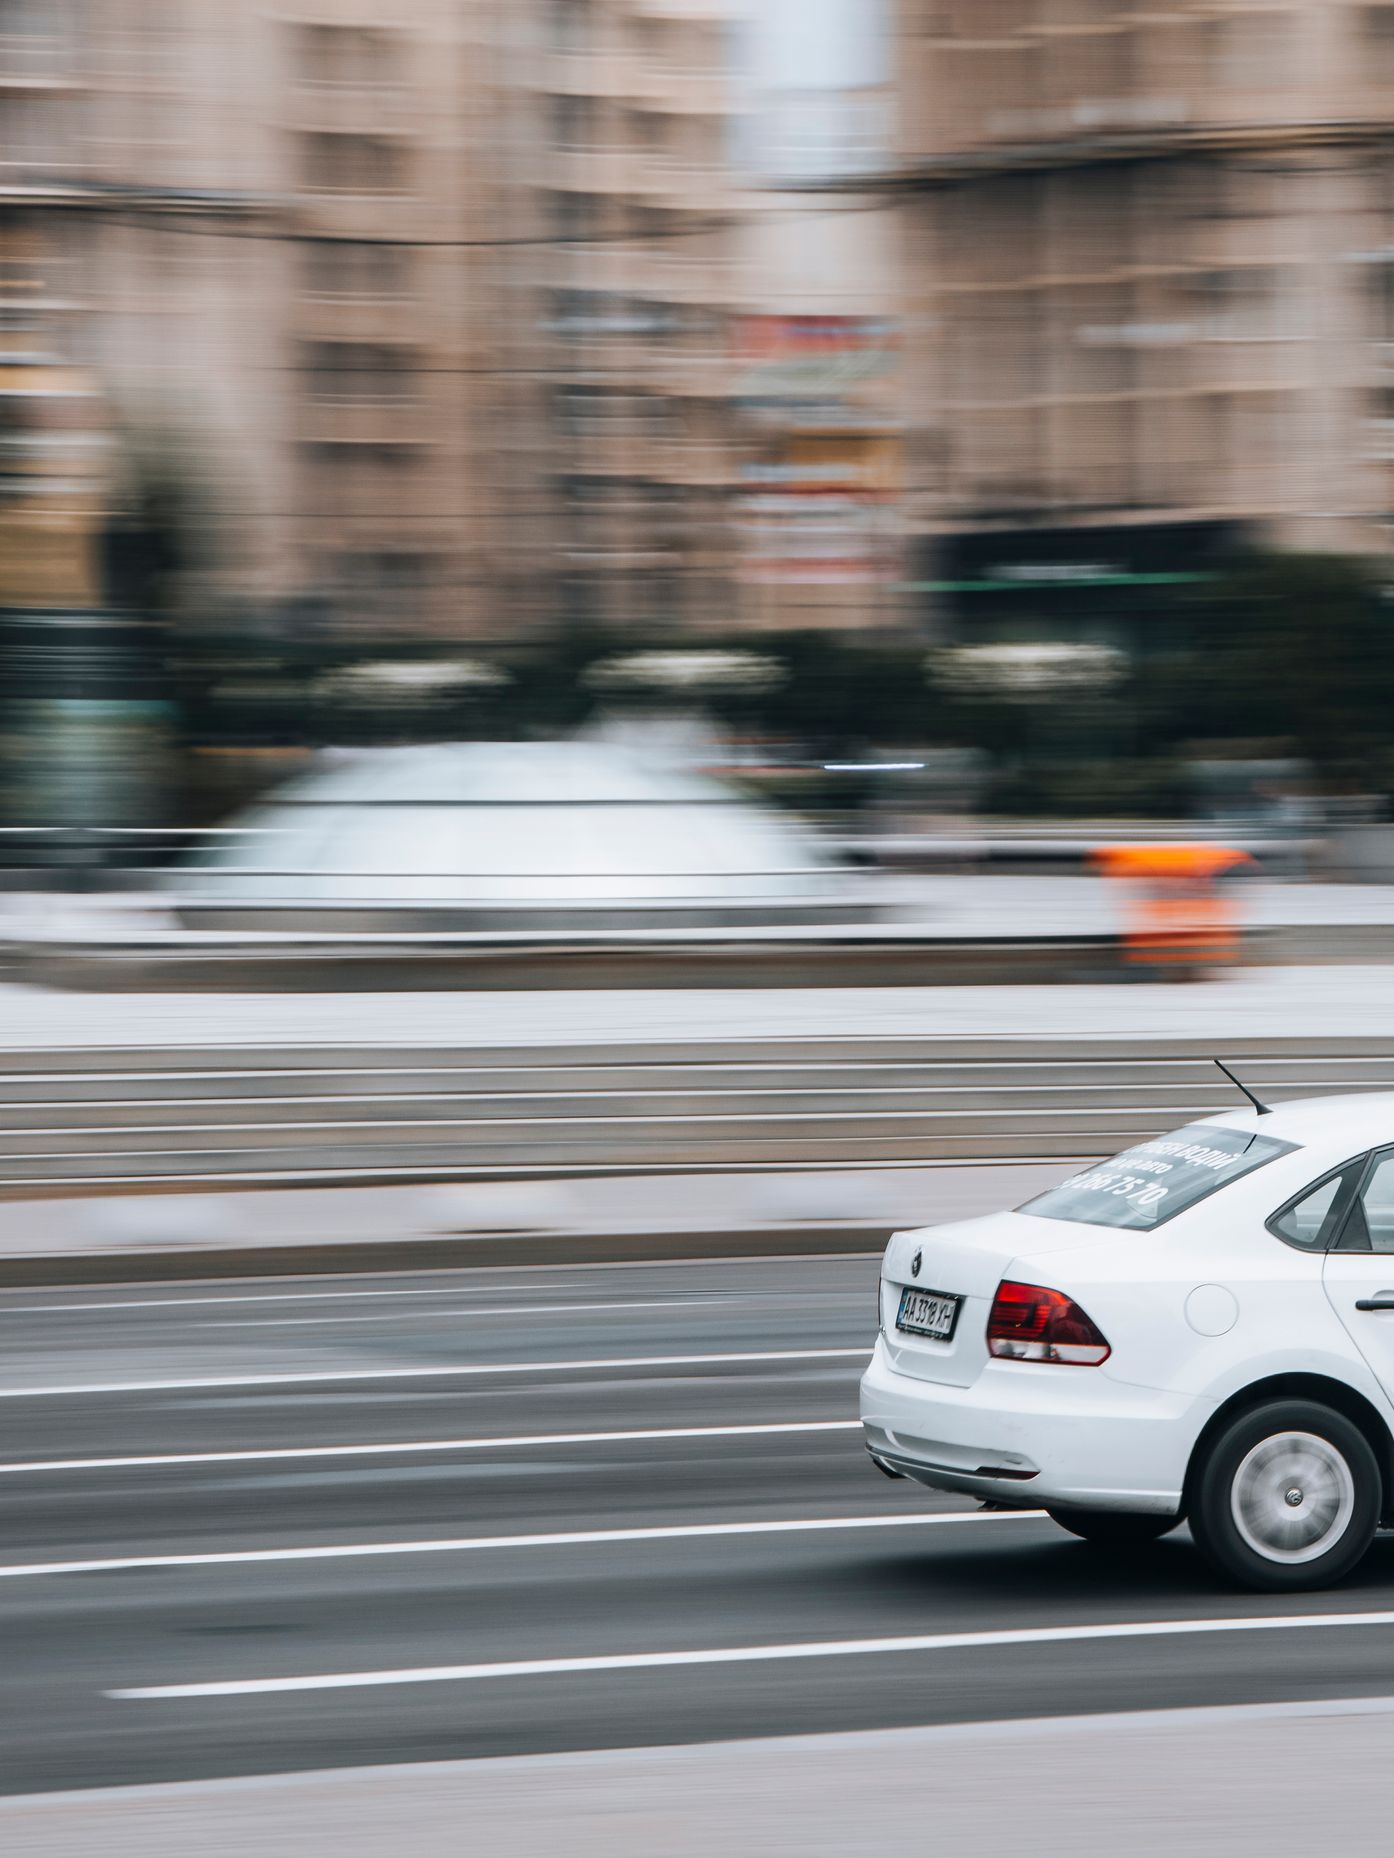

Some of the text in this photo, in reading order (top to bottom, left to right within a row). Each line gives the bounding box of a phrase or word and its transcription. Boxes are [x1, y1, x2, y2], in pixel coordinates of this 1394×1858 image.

[1102, 1176, 1145, 1195] 75
[1126, 1182, 1169, 1205] 70
[903, 1295, 918, 1322] AA
[915, 1298, 939, 1326] 3318
